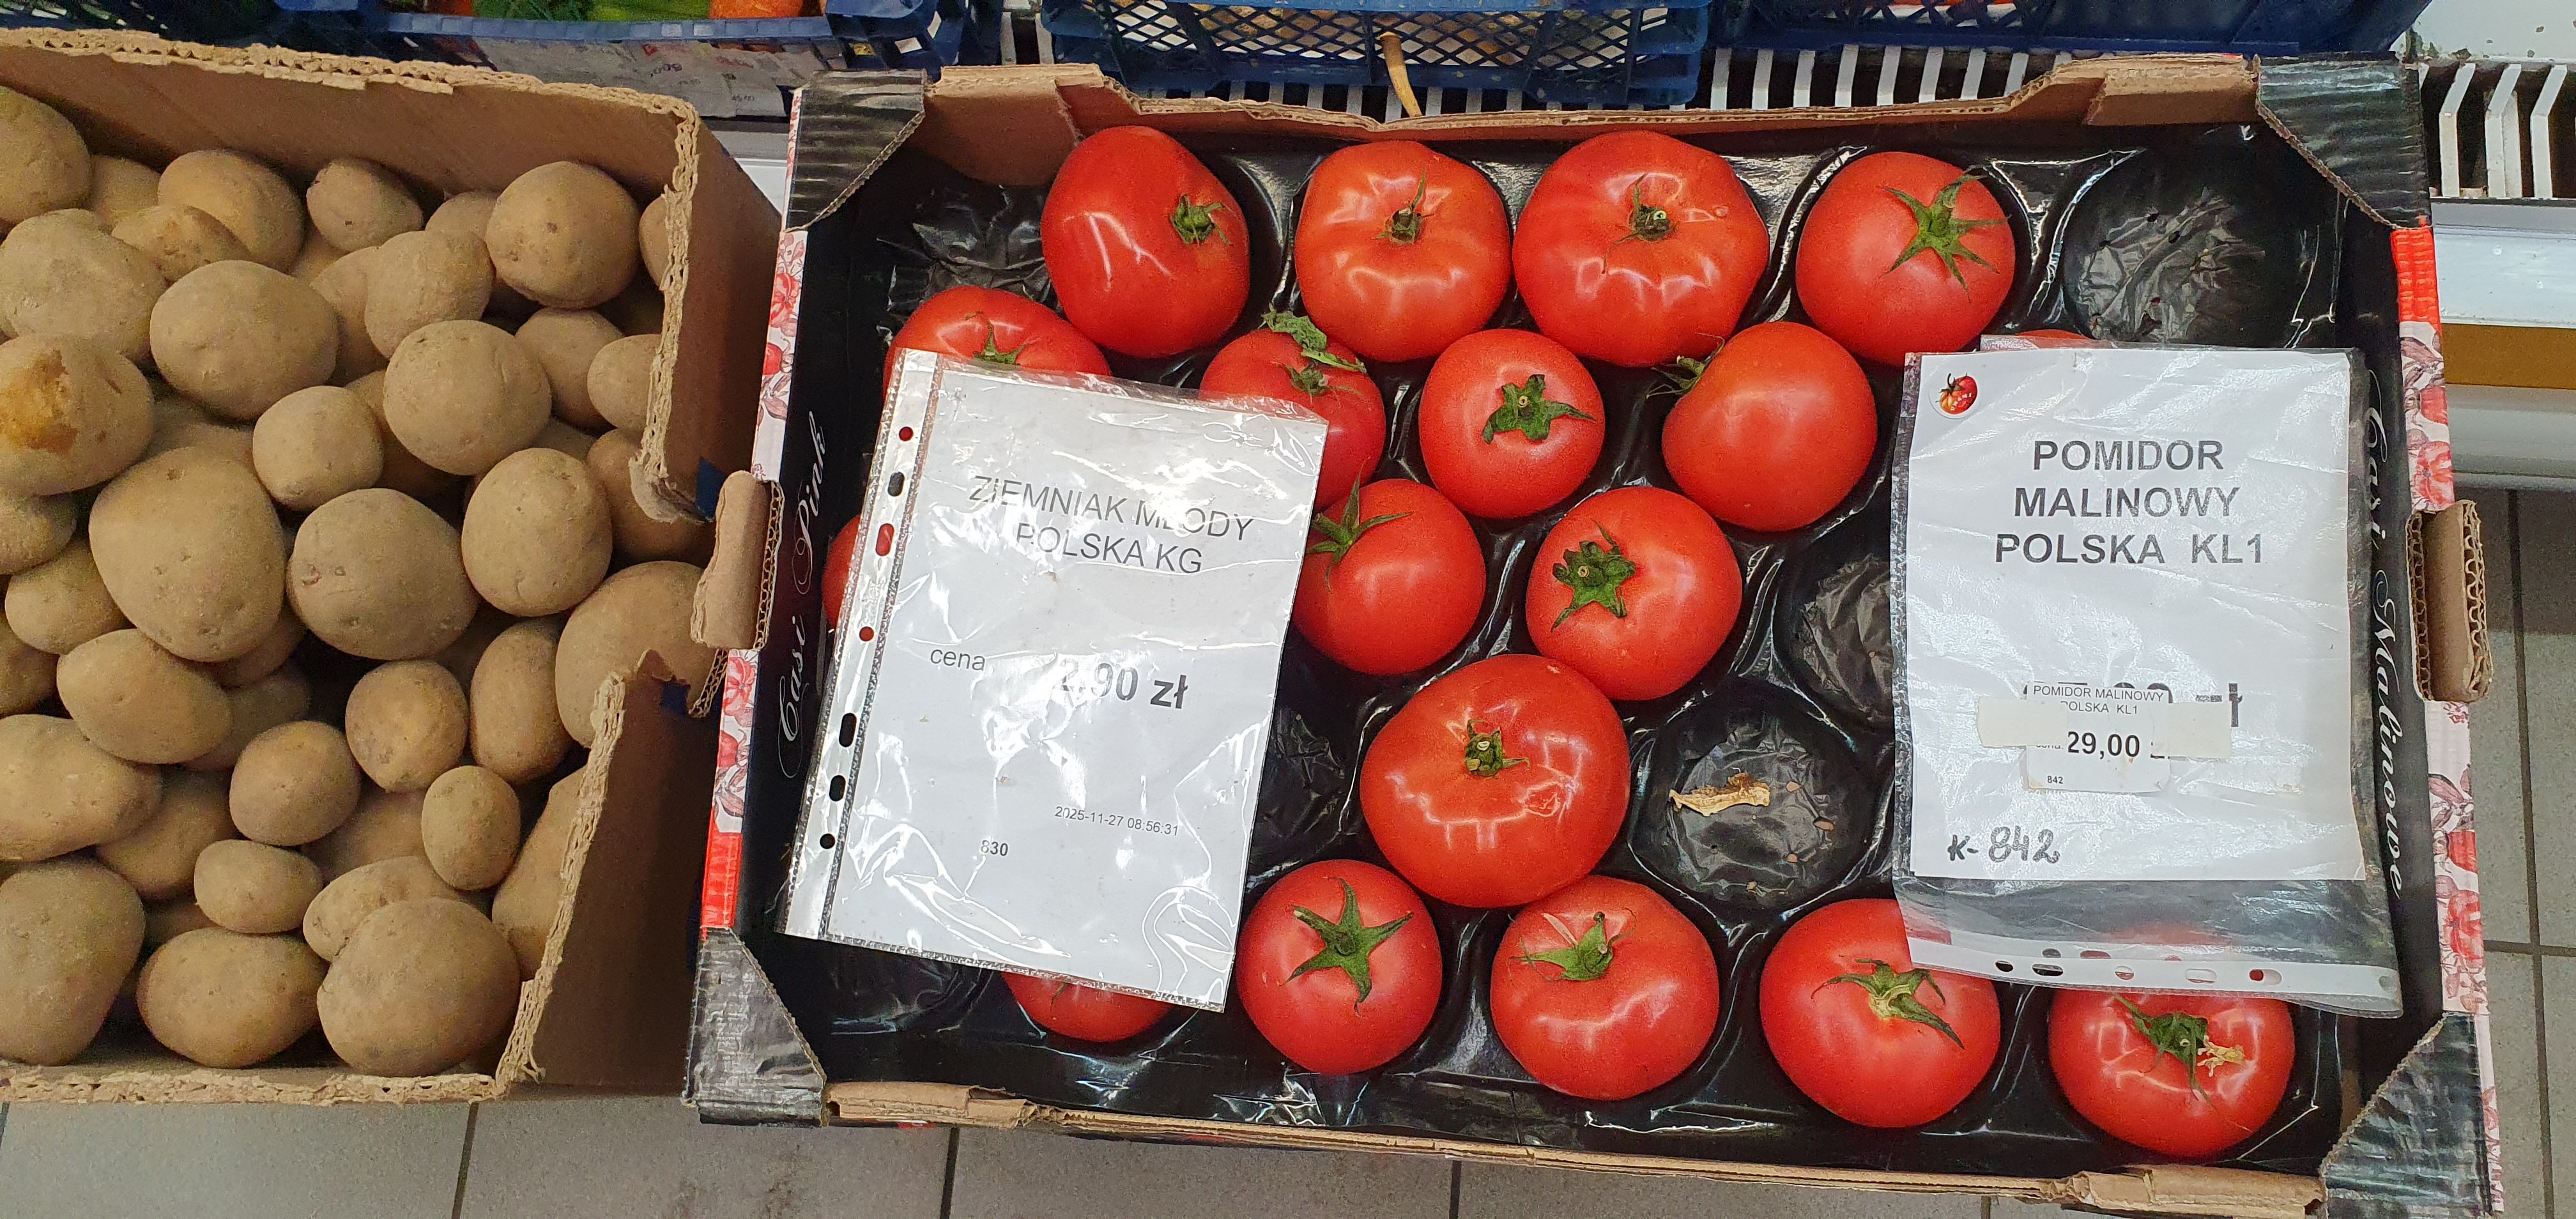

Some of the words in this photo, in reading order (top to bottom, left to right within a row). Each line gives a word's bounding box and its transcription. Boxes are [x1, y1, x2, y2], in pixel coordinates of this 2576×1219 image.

[2033, 440, 2225, 471] POMIDOR
[969, 475, 1128, 524] ZIEMNIAK
[2014, 486, 2241, 518] MALINOWY
[1016, 521, 1145, 567] POLSKA
[1155, 542, 1203, 574] KG
[1995, 533, 2166, 564] POLSKA
[2191, 533, 2262, 564] KL1
[930, 648, 986, 671] cena
[1149, 673, 1189, 710] zł
[2033, 684, 2092, 698] POMIDOR
[2095, 688, 2165, 702] MALINOWY
[2116, 704, 2138, 715] KL1
[2067, 731, 2140, 760] 29,00
[2046, 775, 2064, 785] 842
[1054, 805, 1124, 827] 2025-11-27
[1126, 816, 1179, 836] 08:56:31
[979, 839, 1009, 857] 830
